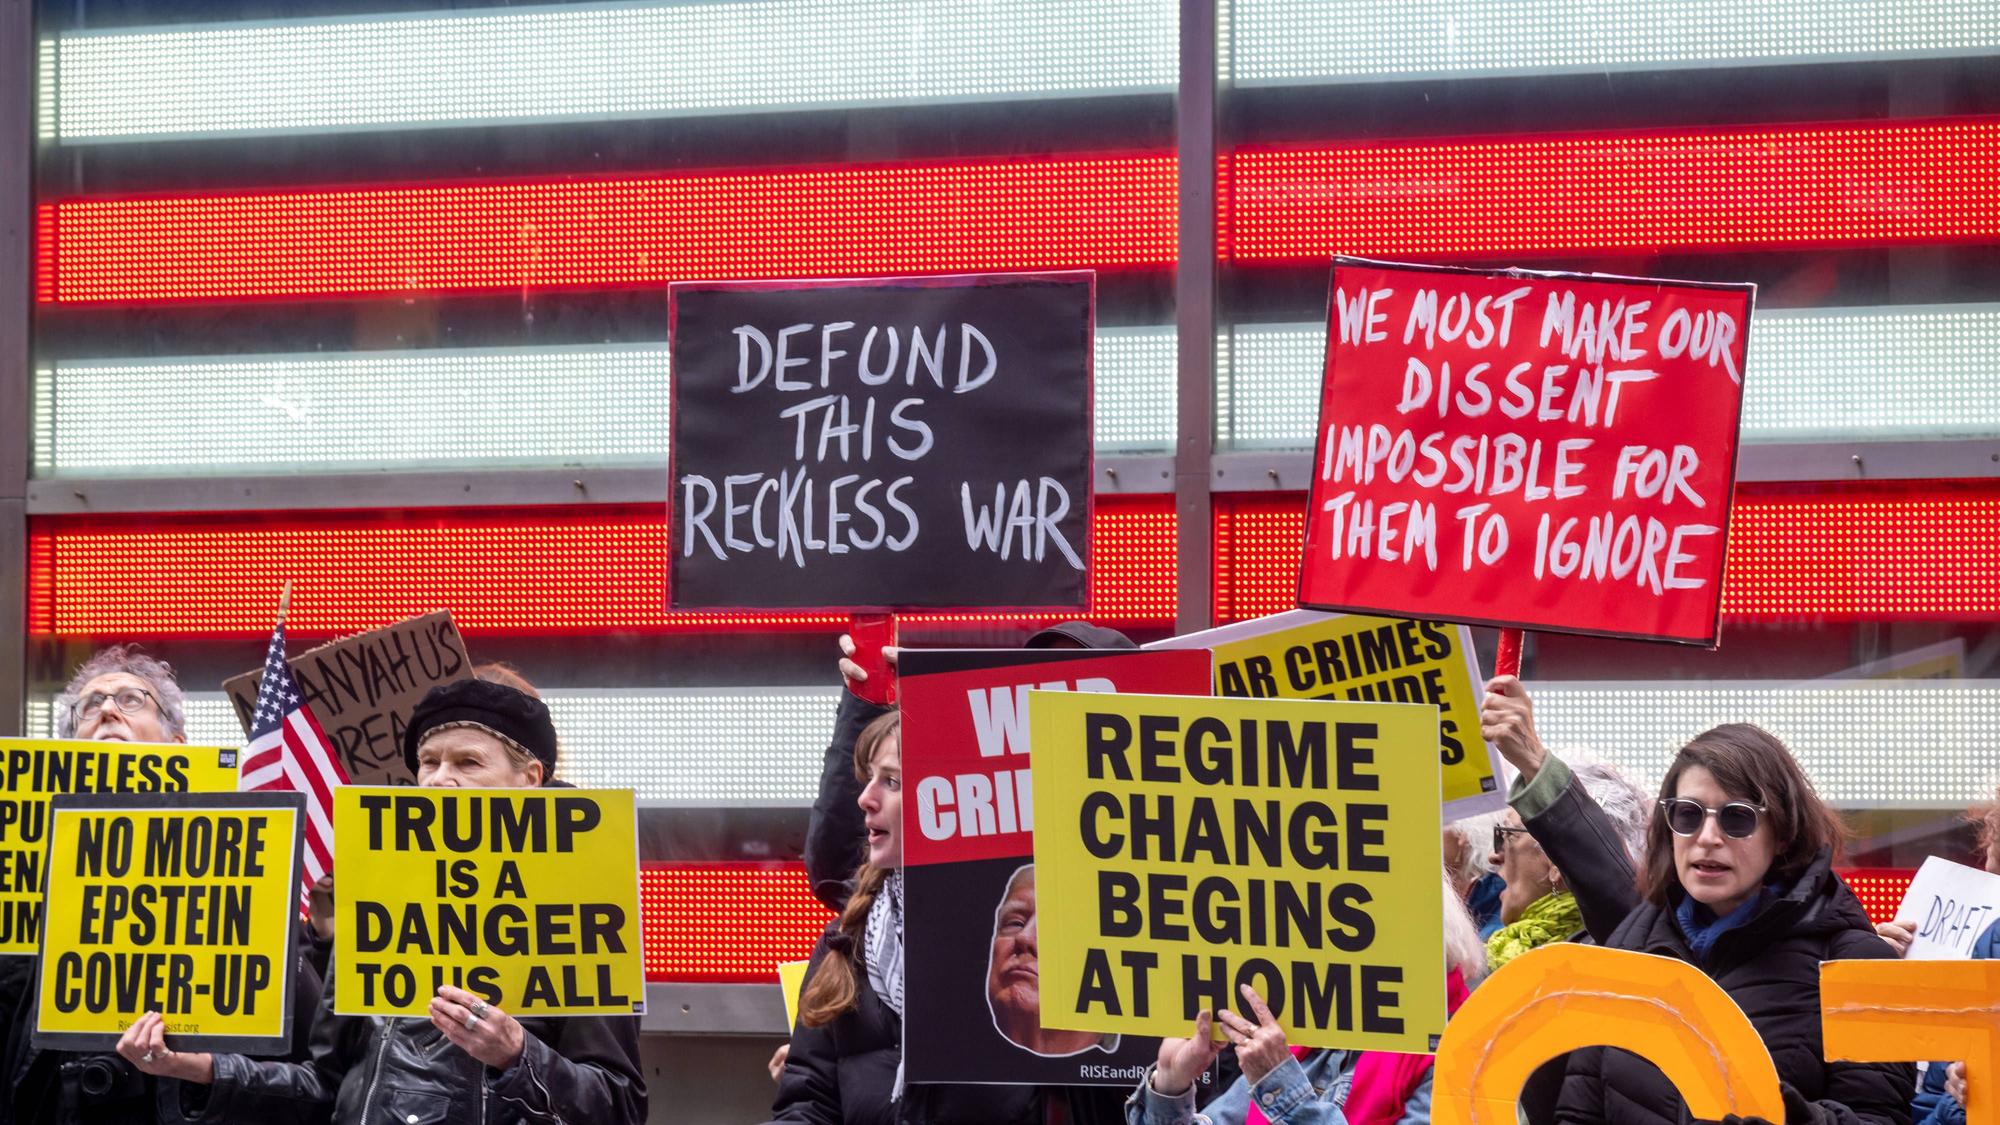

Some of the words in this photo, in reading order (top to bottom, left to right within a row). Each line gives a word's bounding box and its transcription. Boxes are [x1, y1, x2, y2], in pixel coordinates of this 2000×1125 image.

[730, 321, 998, 394] DEFUND
[1337, 287, 1394, 347] WE
[1403, 286, 1533, 350] MUST
[1540, 289, 1652, 364] MAKE
[1658, 307, 1740, 384] OUR
[779, 394, 934, 462] THIS
[1396, 357, 1661, 428] DISSENT
[1322, 424, 1595, 501] IMPOSSIBLE
[1613, 445, 1705, 508] FOR
[681, 466, 919, 568] RECKLESS
[961, 477, 1086, 570] WAR
[1322, 491, 1437, 572] THEM
[1456, 503, 1508, 571] TO
[1534, 511, 1720, 595] IGNORE
[1216, 655, 1279, 698] AR
[1285, 620, 1452, 691] CRIMES
[0, 749, 190, 793] PINELESS
[1085, 712, 1380, 791] REGIME
[75, 816, 134, 878] NO
[143, 816, 268, 878] MORE
[360, 795, 601, 853] TRUMP
[1080, 790, 1390, 873] CHANGE
[436, 859, 479, 898] IS
[493, 860, 527, 899] A
[1097, 870, 1376, 952] BEGINS
[79, 884, 251, 946] EPSTEIN
[355, 900, 627, 957] DANGER
[1920, 895, 1993, 956] DRAFT
[54, 951, 271, 1016] COVER-UP
[356, 963, 416, 1008] TO
[521, 964, 629, 1008] ALL
[1075, 948, 1158, 1018] AT
[1181, 954, 1405, 1034] HOME
